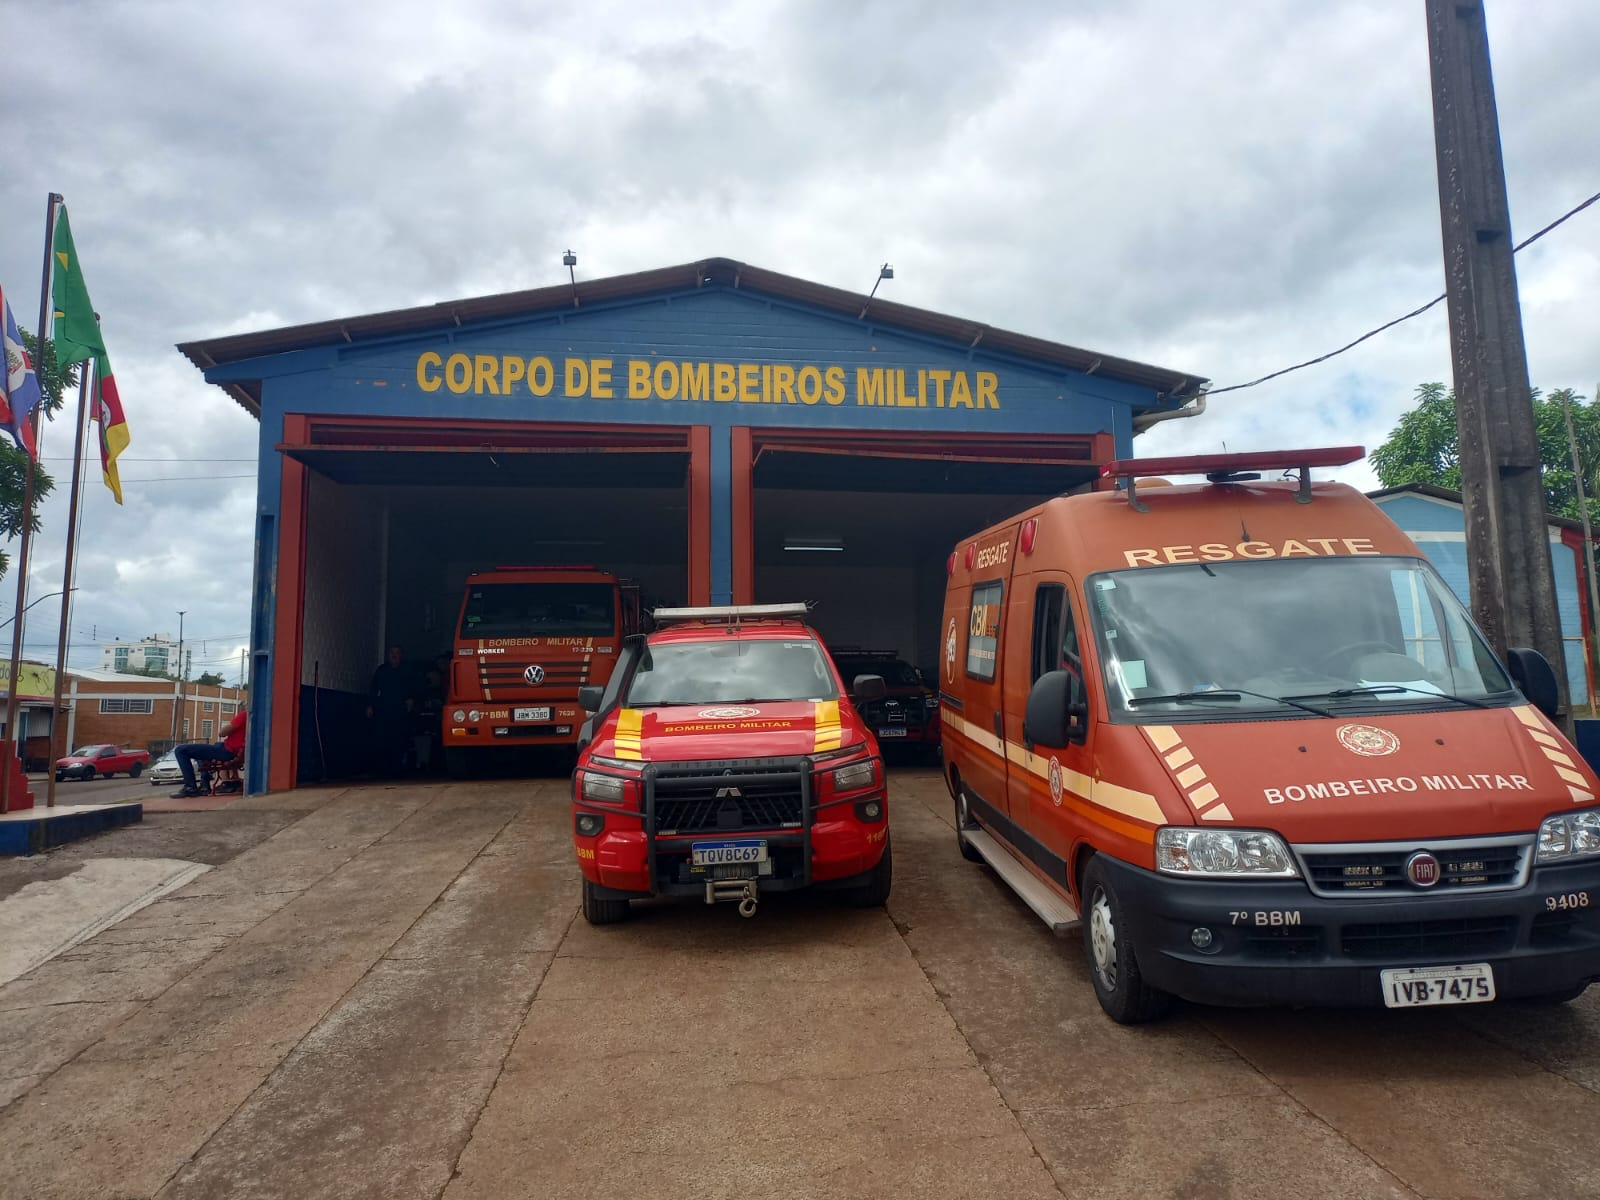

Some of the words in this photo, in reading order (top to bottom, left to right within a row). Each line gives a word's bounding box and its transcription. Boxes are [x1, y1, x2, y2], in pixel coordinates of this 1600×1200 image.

[416, 352, 554, 397] CORPO
[564, 358, 613, 399] DE
[627, 360, 846, 405] BOMBEIROS
[856, 367, 1001, 410] MILITAR
[976, 541, 1010, 569] RESGATE
[1123, 538, 1381, 568] RESGATE
[489, 638, 539, 647] BOMBEIRO
[546, 637, 583, 646] MILITAR
[490, 710, 509, 719] BBM
[664, 723, 736, 733] BOMBEIRO
[740, 721, 792, 729] MILITAR
[671, 757, 785, 769] MITSUBISHI
[1263, 776, 1418, 804] BOMBEIRO
[1420, 774, 1534, 791] MILITAR
[699, 848, 759, 863] TQV8C69
[1415, 863, 1435, 879] FIAT
[1545, 892, 1589, 911] 9408
[1255, 911, 1301, 926] BBM
